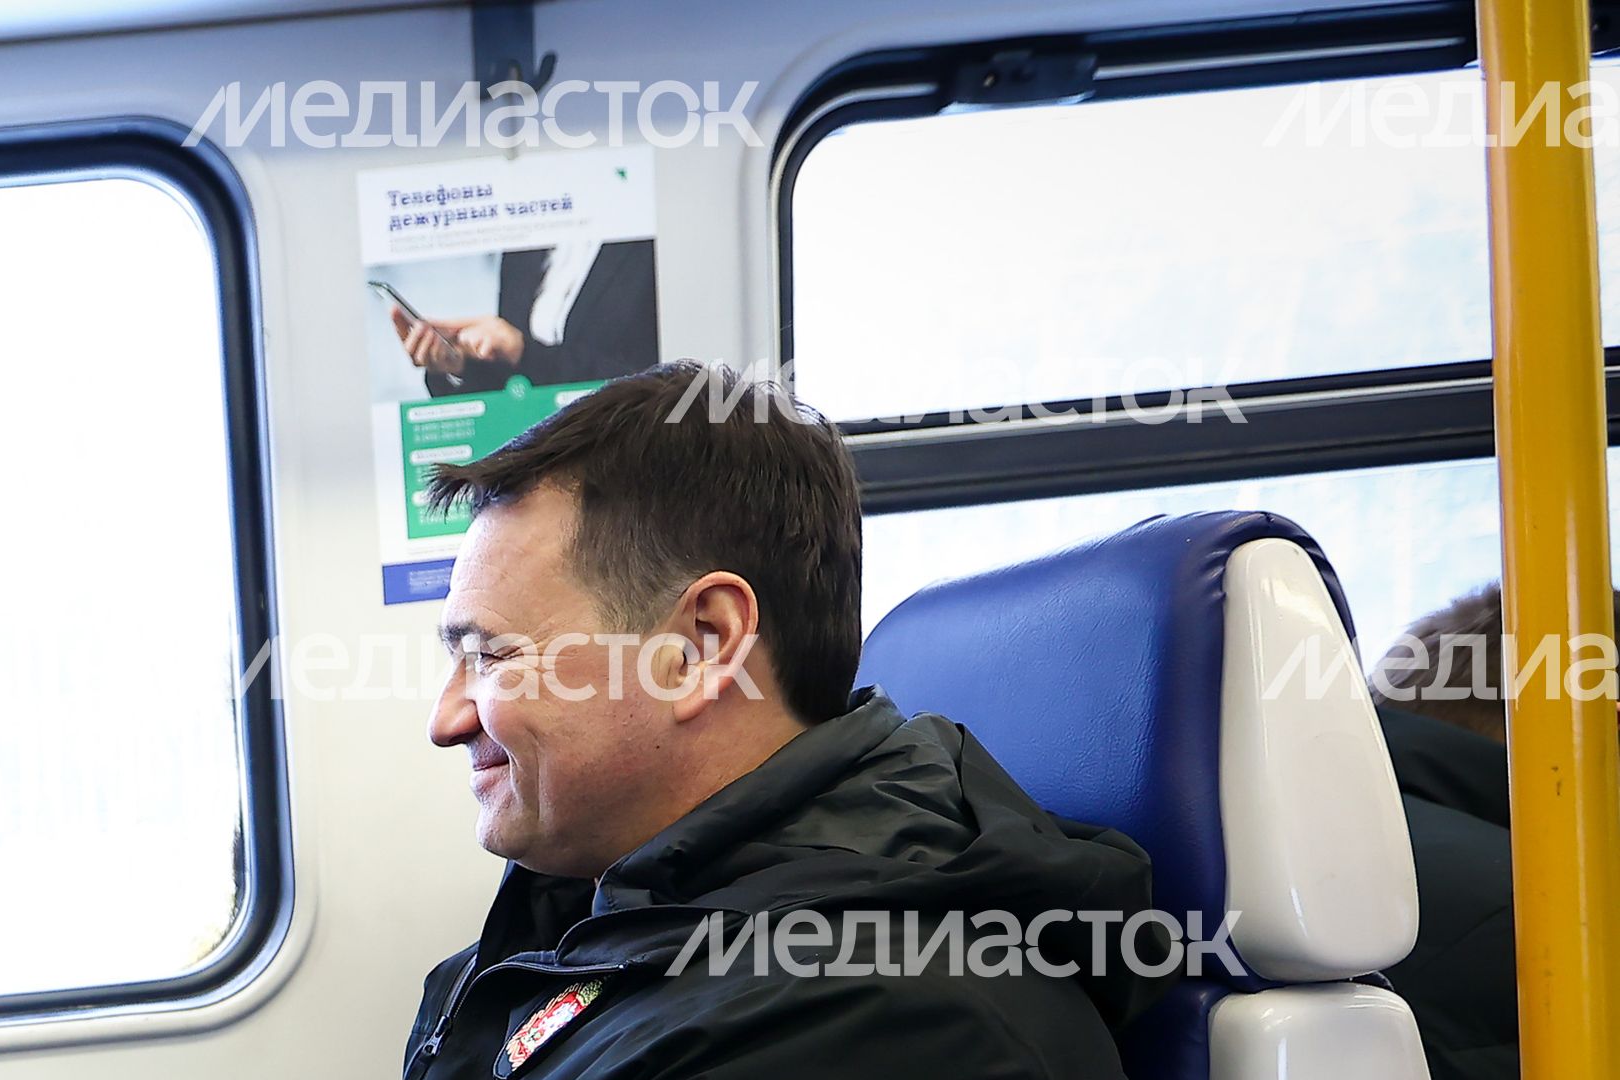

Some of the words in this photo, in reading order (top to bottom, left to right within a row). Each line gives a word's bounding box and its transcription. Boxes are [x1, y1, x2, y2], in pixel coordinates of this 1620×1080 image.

[388, 184, 493, 207] Телефоны
[390, 204, 499, 231] дежурных
[505, 193, 573, 216] частей
